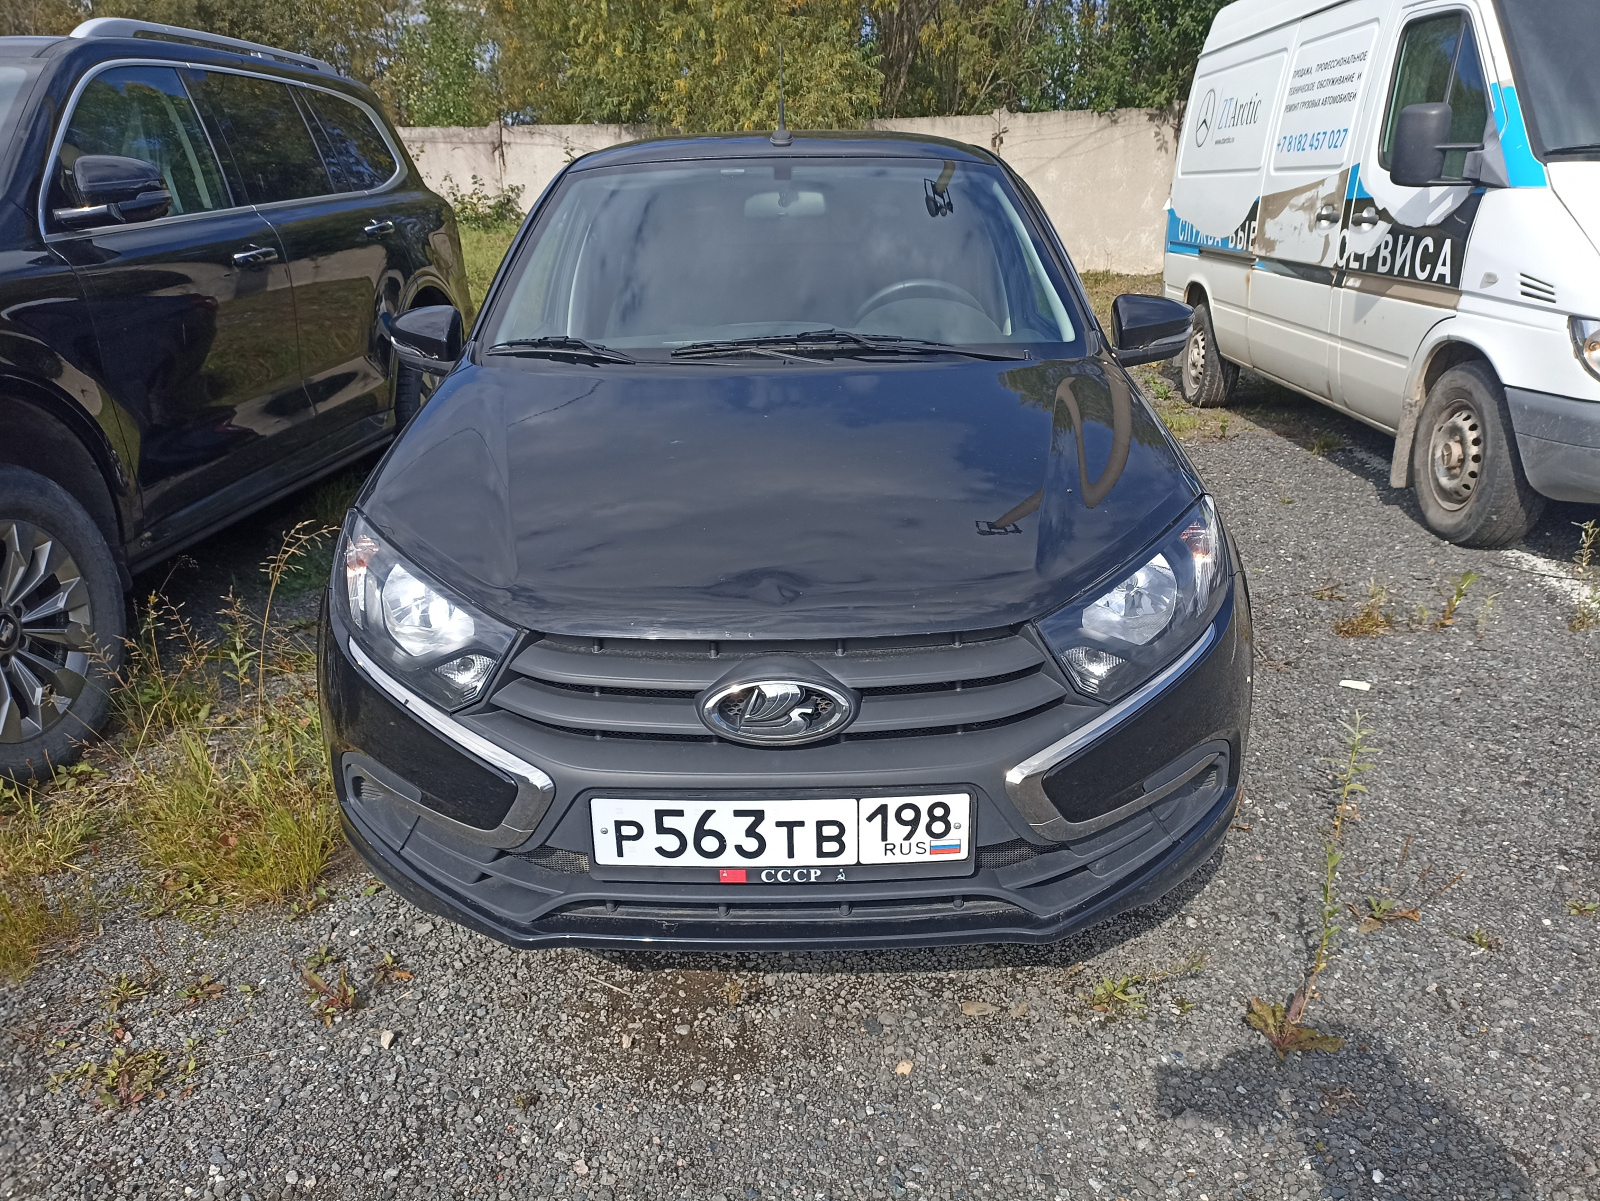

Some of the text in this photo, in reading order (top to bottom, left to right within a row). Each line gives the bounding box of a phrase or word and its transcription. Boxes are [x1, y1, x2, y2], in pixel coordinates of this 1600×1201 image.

[1315, 50, 1368, 72] ПРОФЕССИОНАЛЬНОЕ
[1316, 72, 1356, 90] ОБСЛУЖИВАНИЕ
[1357, 71, 1363, 81] И
[1217, 92, 1262, 130] ZTArctic
[1284, 89, 1358, 114] РЕМОНТ ГРУЗОВЫХ АВТОМОБИЛЕЙ
[1277, 128, 1349, 153] +7 8182 457 027
[614, 801, 952, 860] Р563ТВ 198
[884, 842, 927, 855] RUS
[760, 868, 822, 883] СССР
